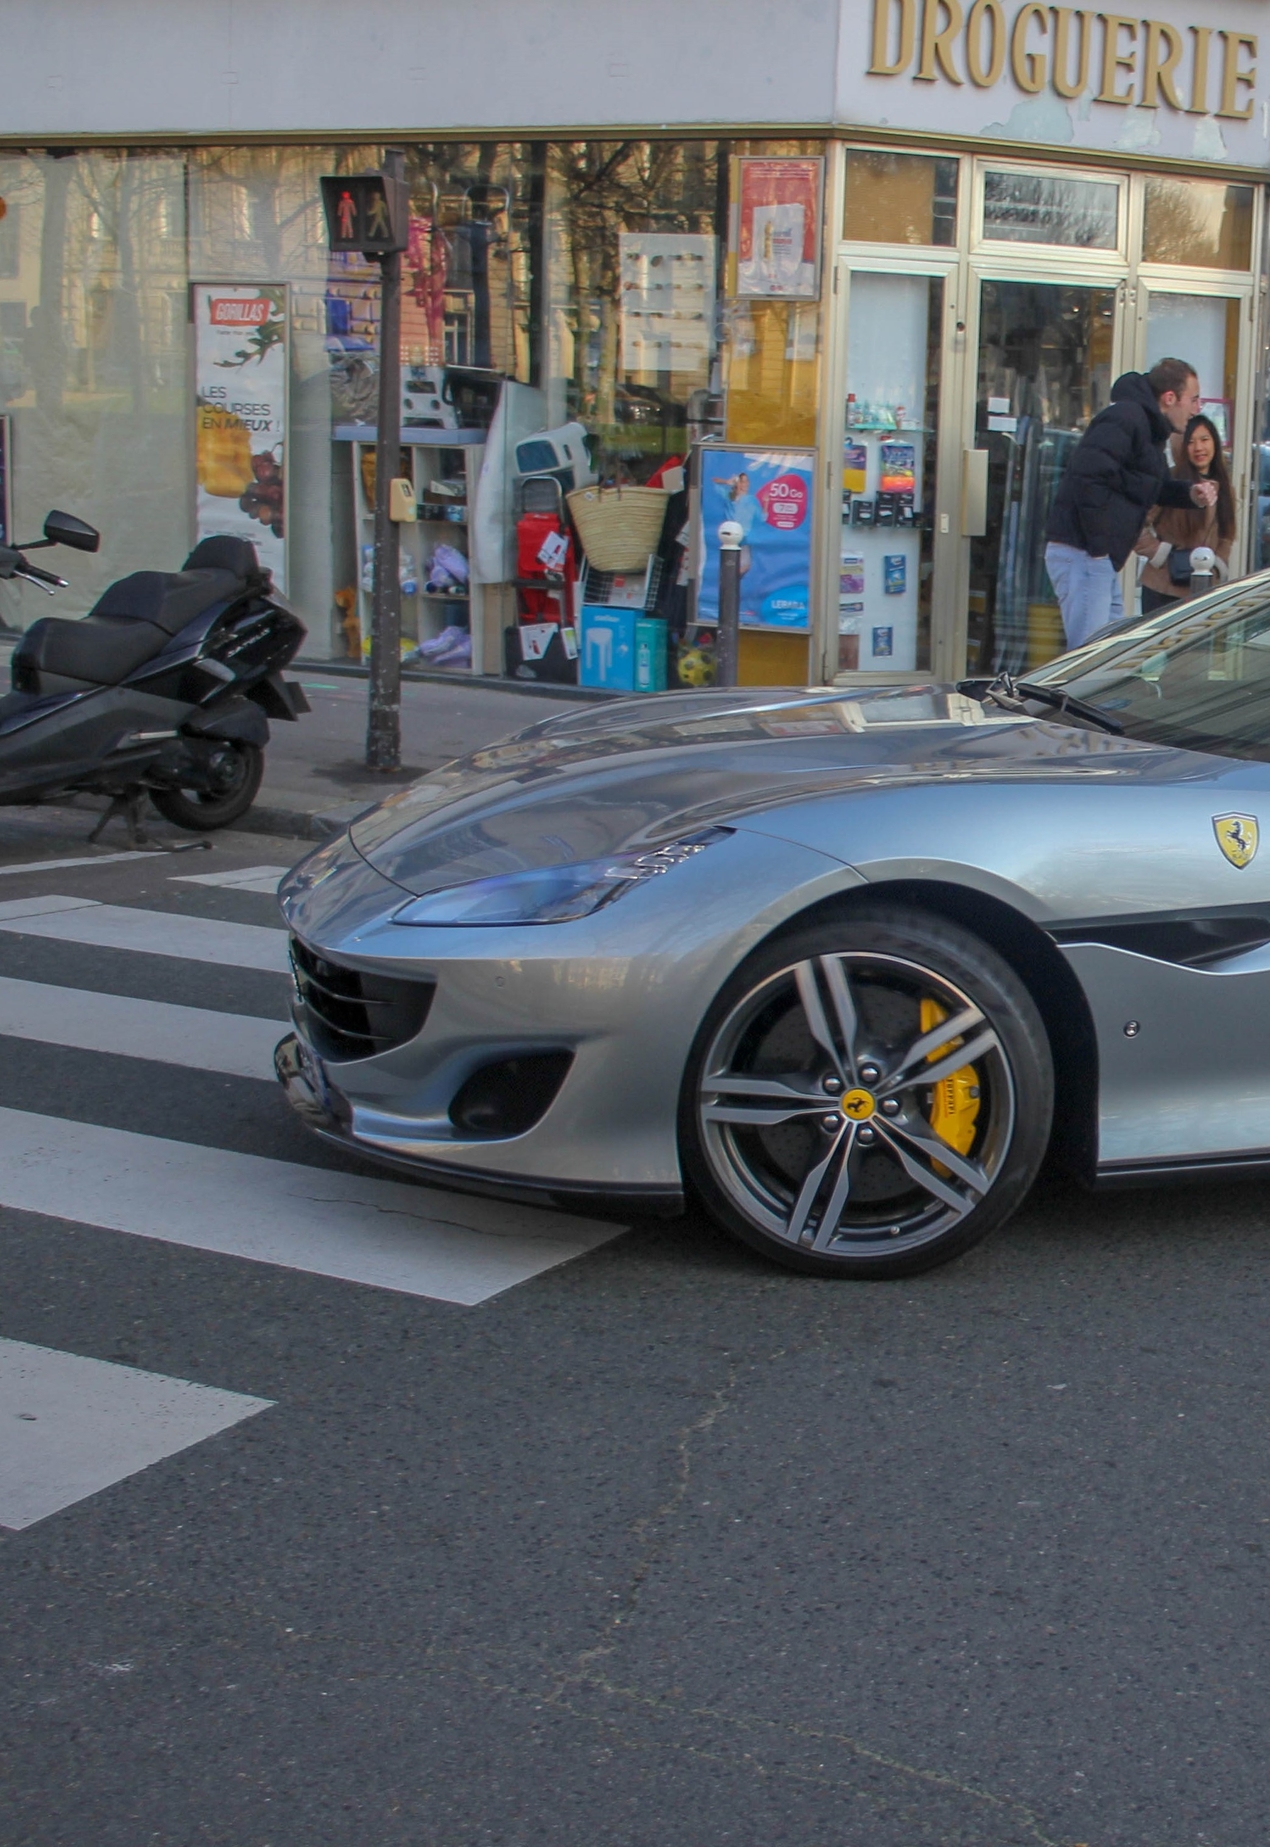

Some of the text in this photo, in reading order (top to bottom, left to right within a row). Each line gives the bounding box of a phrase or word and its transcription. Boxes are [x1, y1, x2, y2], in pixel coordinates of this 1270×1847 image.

[867, 0, 1258, 120] DROGUERIE
[215, 303, 265, 321] GORILLAS
[202, 386, 227, 398] LES
[203, 402, 271, 416] COURSES
[203, 417, 223, 429] EN
[225, 419, 273, 432] MIEUX
[769, 483, 789, 497] 50
